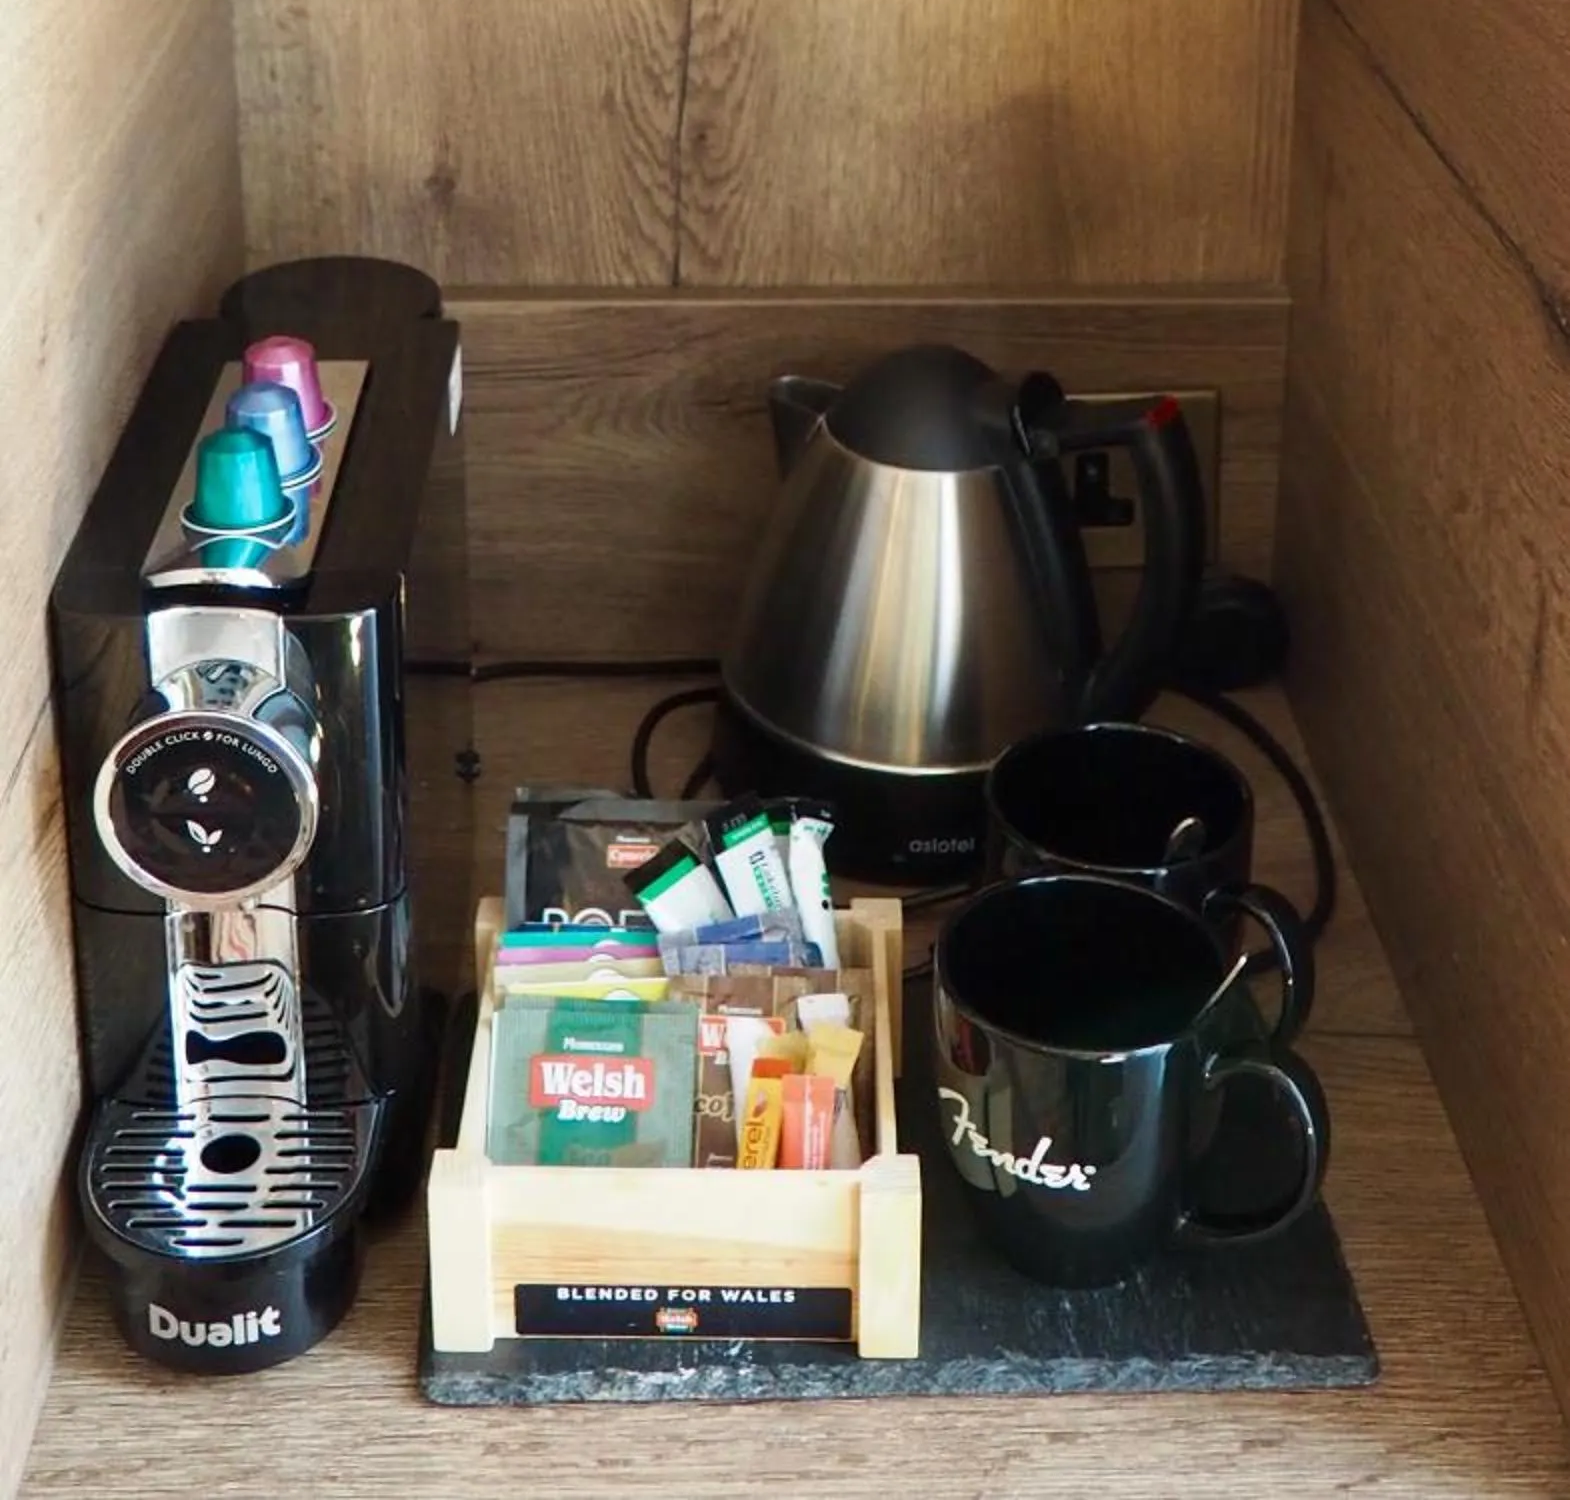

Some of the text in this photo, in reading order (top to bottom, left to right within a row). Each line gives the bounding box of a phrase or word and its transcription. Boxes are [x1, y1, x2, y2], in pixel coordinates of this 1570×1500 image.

[125, 731, 279, 775] DOUBLE CLICK FOR LUNGO
[540, 1062, 646, 1099] Welsh
[556, 1099, 627, 1123] Brew
[938, 1088, 1092, 1192] Fender
[556, 1287, 797, 1303] BLENDED FOR WALES
[149, 1303, 282, 1347] Dualit
